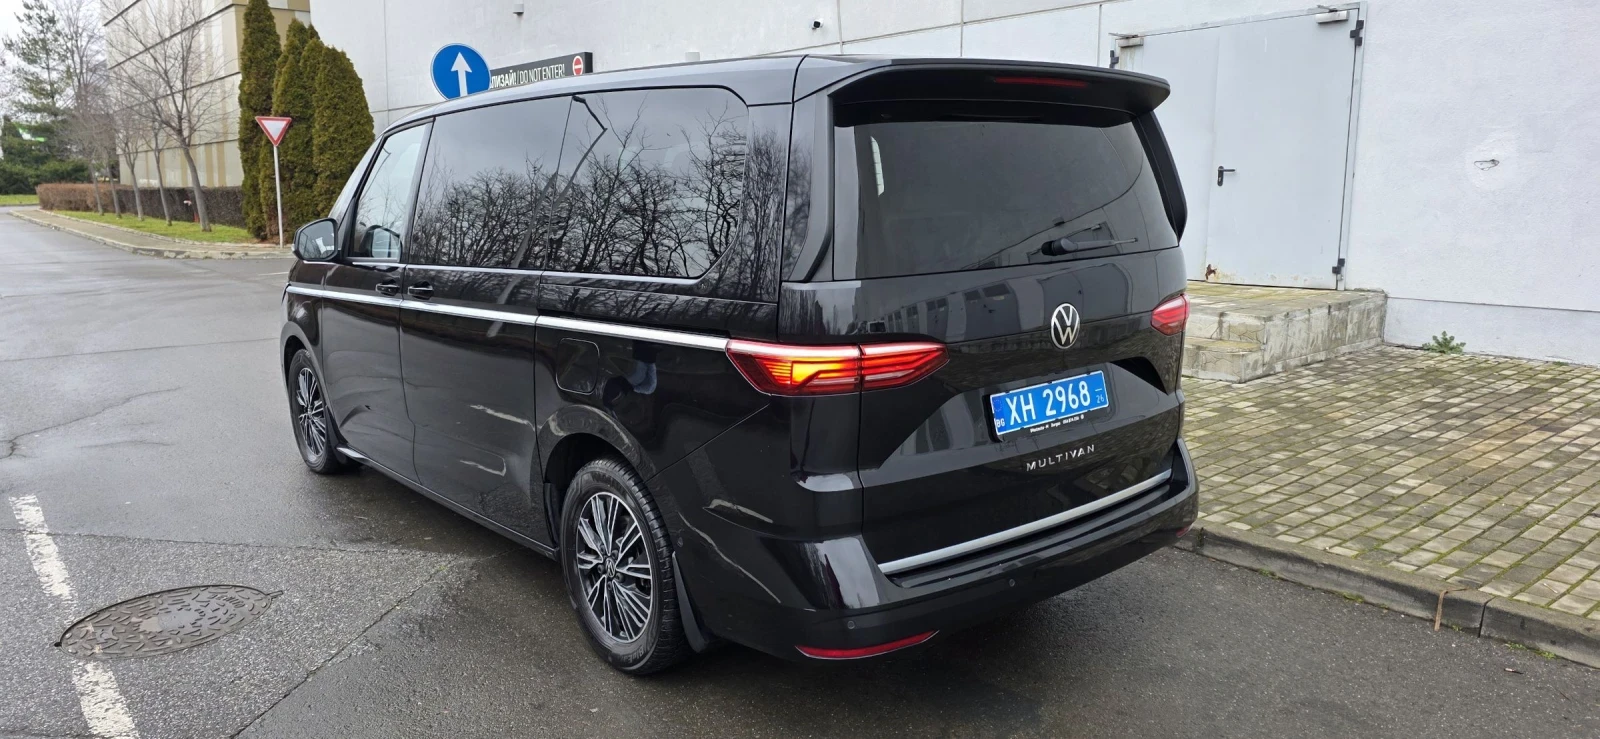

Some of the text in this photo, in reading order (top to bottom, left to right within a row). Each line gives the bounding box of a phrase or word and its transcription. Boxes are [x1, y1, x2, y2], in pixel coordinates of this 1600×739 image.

[490, 70, 517, 88] ЛИЗАЙ!
[520, 70, 529, 84] DO
[529, 68, 541, 82] NOT
[542, 64, 565, 80] ENTER!
[1051, 303, 1080, 349] VW
[1005, 381, 1091, 426] XH 2968
[1096, 395, 1105, 404] 26
[996, 418, 1006, 428] BG
[1026, 444, 1095, 471] MULTIVAN
